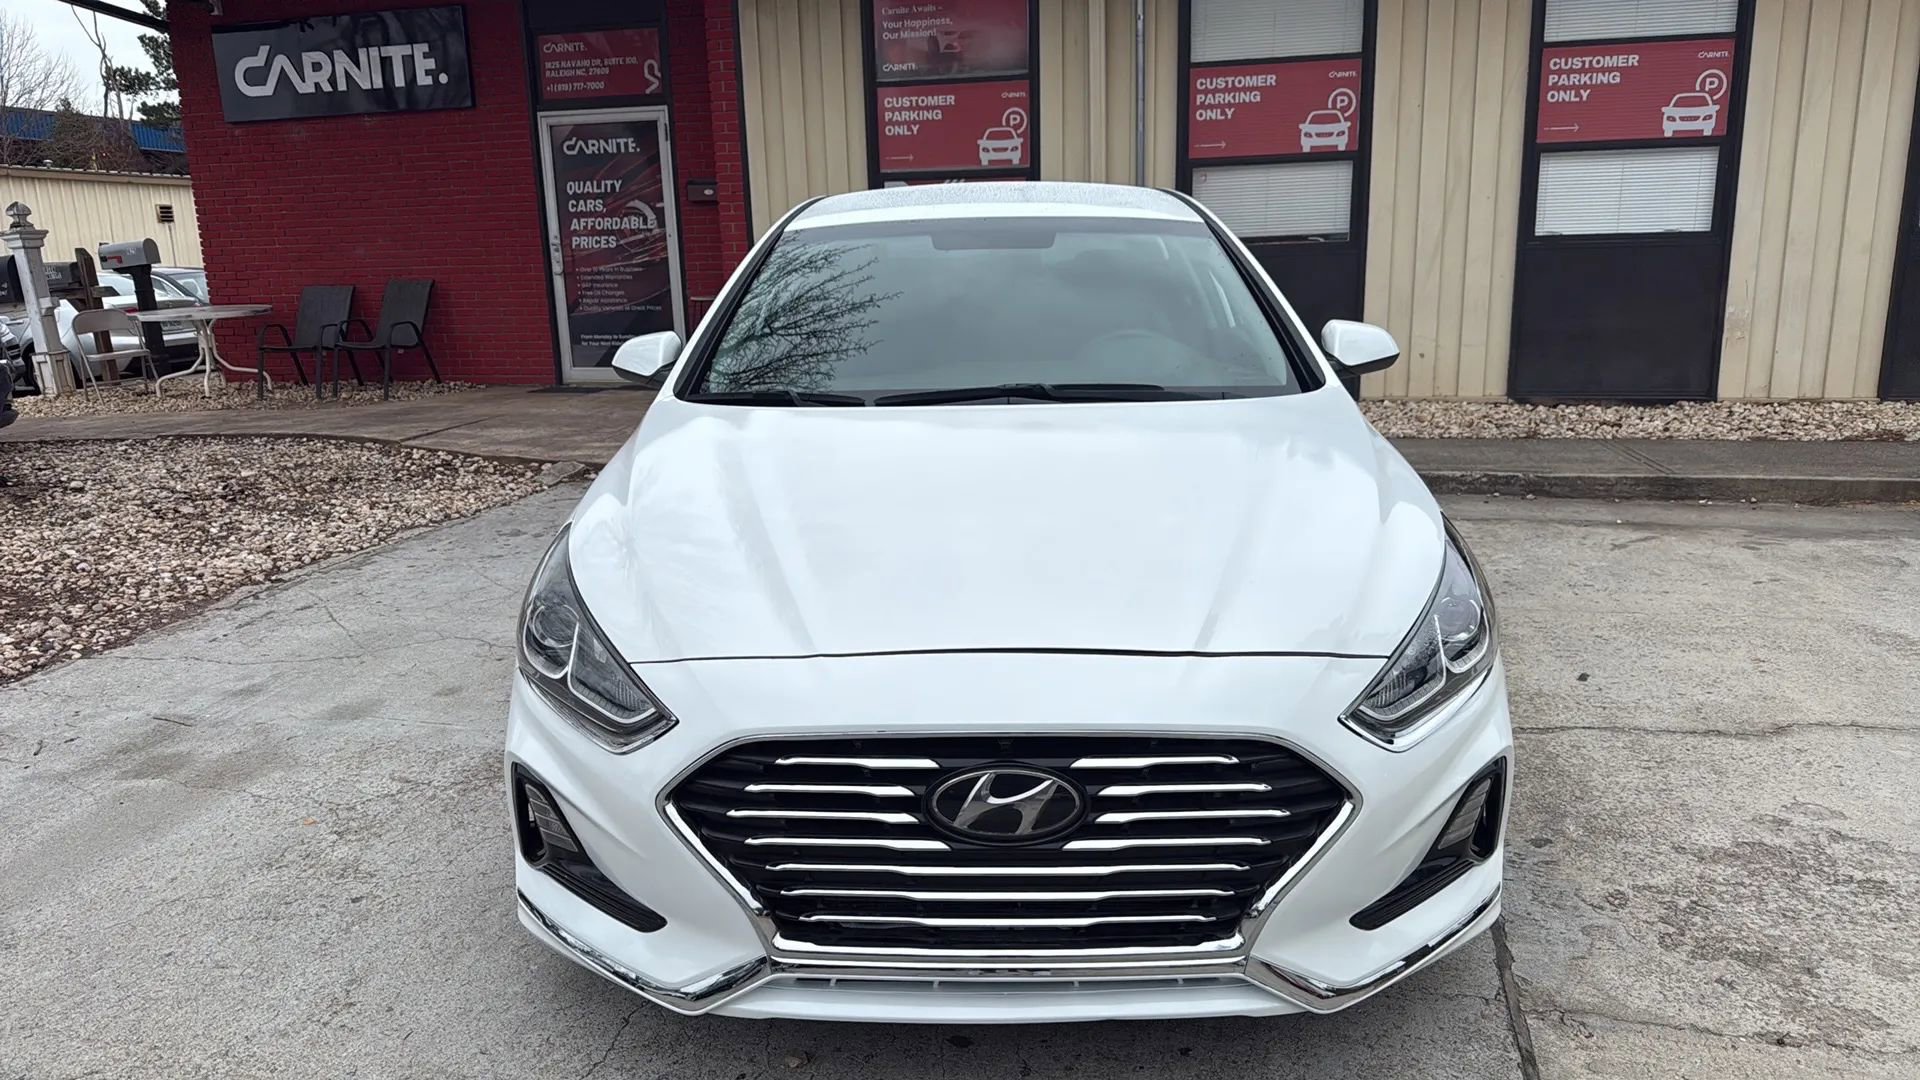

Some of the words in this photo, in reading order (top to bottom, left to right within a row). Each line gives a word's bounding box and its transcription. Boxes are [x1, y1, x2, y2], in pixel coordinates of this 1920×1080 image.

[913, 3, 937, 13] Awaits
[883, 20, 903, 29] Your
[904, 17, 953, 28] Happiness,
[883, 32, 899, 40] Our
[901, 28, 937, 38] Mission!
[1549, 55, 1639, 70] CUSTOMER
[545, 69, 575, 78] RALEIGH
[1548, 71, 1621, 87] PARKING
[1196, 74, 1277, 90] CUSTOMER
[884, 95, 956, 108] CUSTOMER
[1196, 91, 1261, 106] PARKING
[1547, 89, 1591, 103] ONLY
[885, 110, 943, 122] PARKING
[1196, 107, 1236, 121] ONLY
[885, 125, 920, 136] ONLY
[566, 180, 622, 195] QUALITY
[568, 199, 607, 214] CARS,
[570, 216, 657, 231] AFFORDABLE
[572, 236, 617, 249] PRICES
